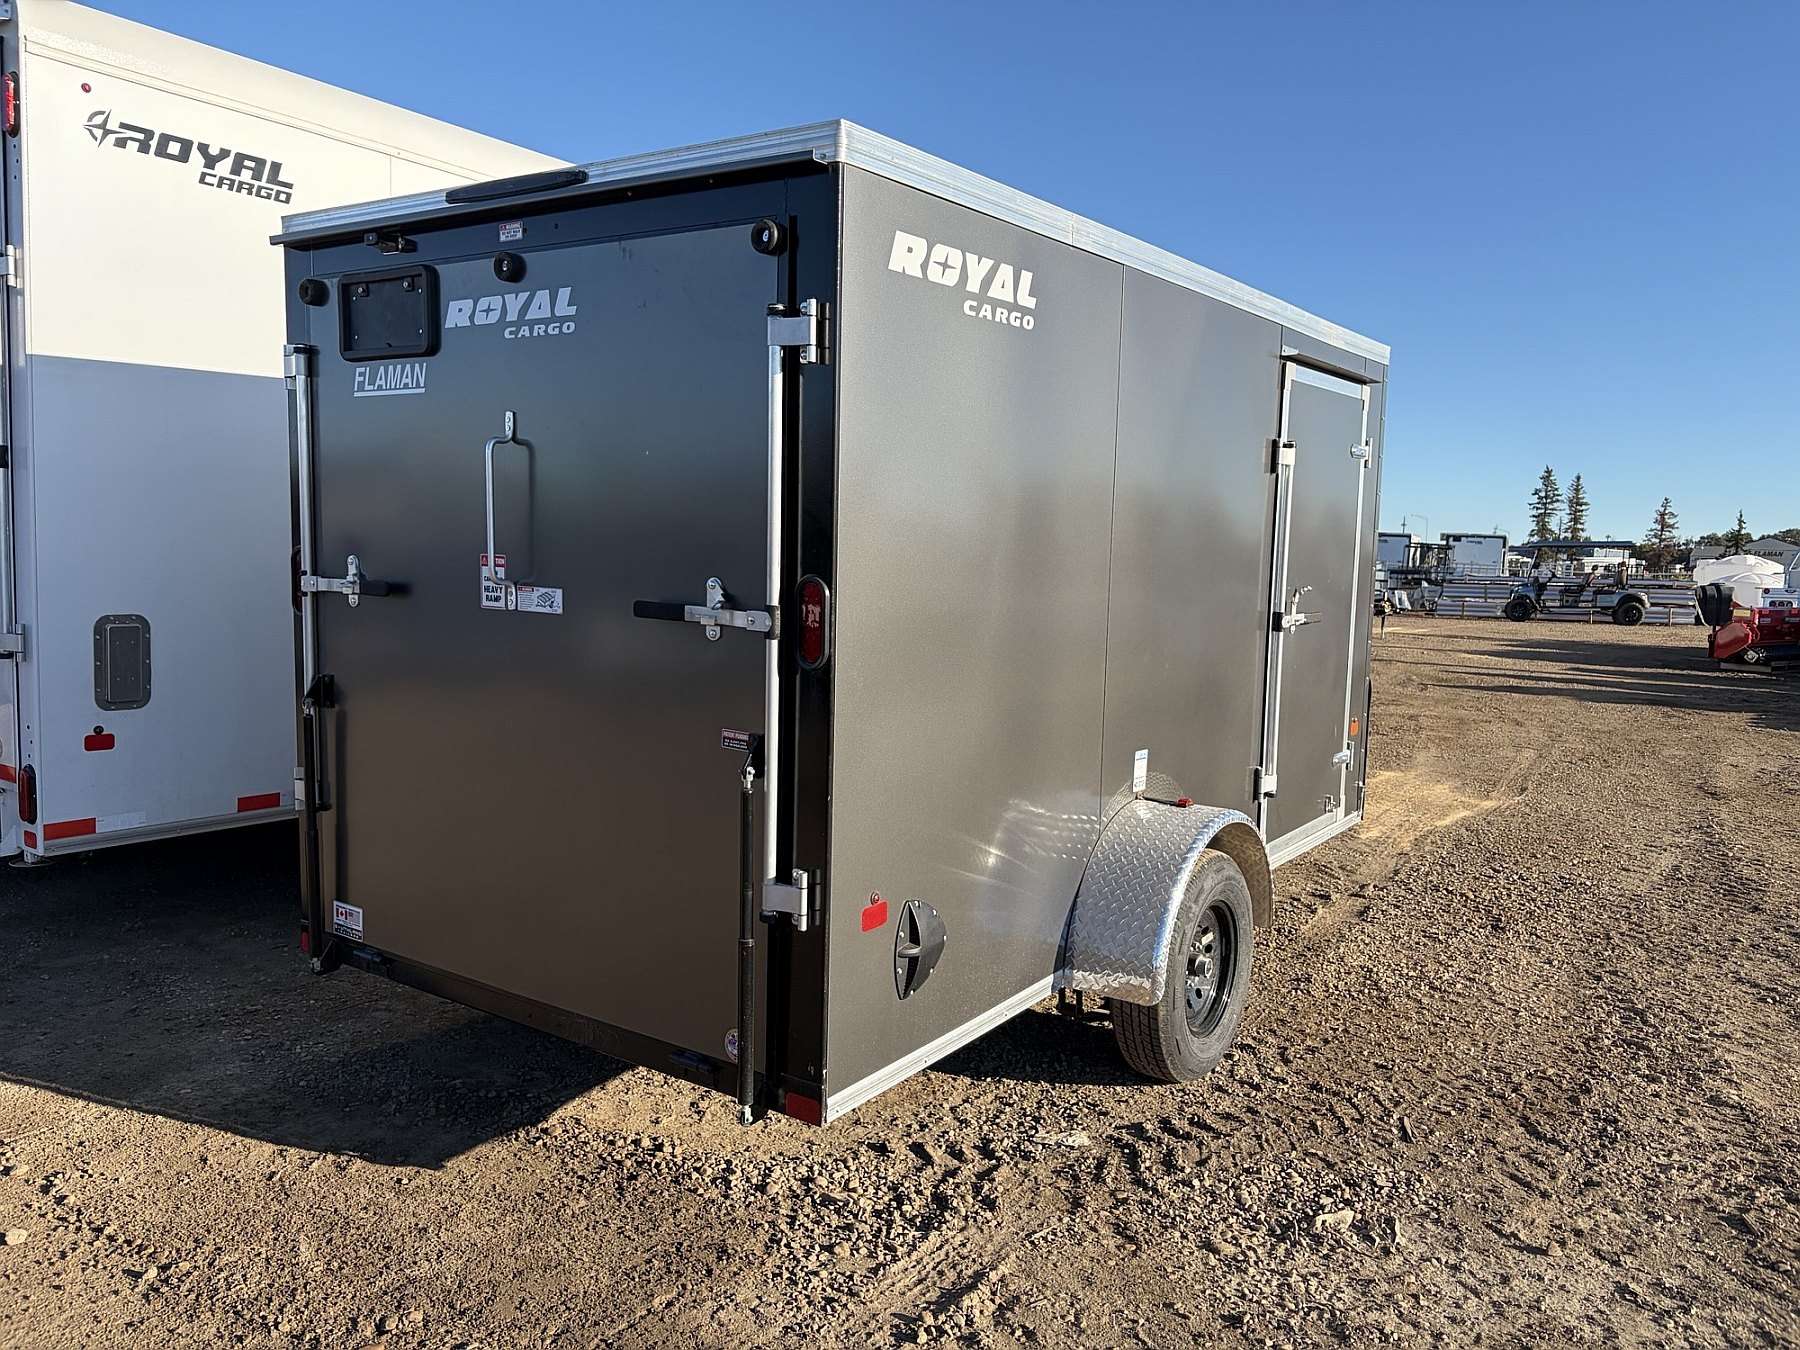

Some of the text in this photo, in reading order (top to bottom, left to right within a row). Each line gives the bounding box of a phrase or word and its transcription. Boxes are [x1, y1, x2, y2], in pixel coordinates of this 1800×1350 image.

[113, 121, 294, 189] ROYAL
[198, 171, 293, 205] CARGO
[887, 230, 1037, 310] ROYAL
[445, 287, 577, 329] ROYAL
[963, 299, 1035, 330] CARGO
[504, 321, 576, 339] CARGO
[354, 362, 427, 391] FLAMAN
[484, 585, 503, 594] HEAVY
[485, 594, 502, 603] RAMP
